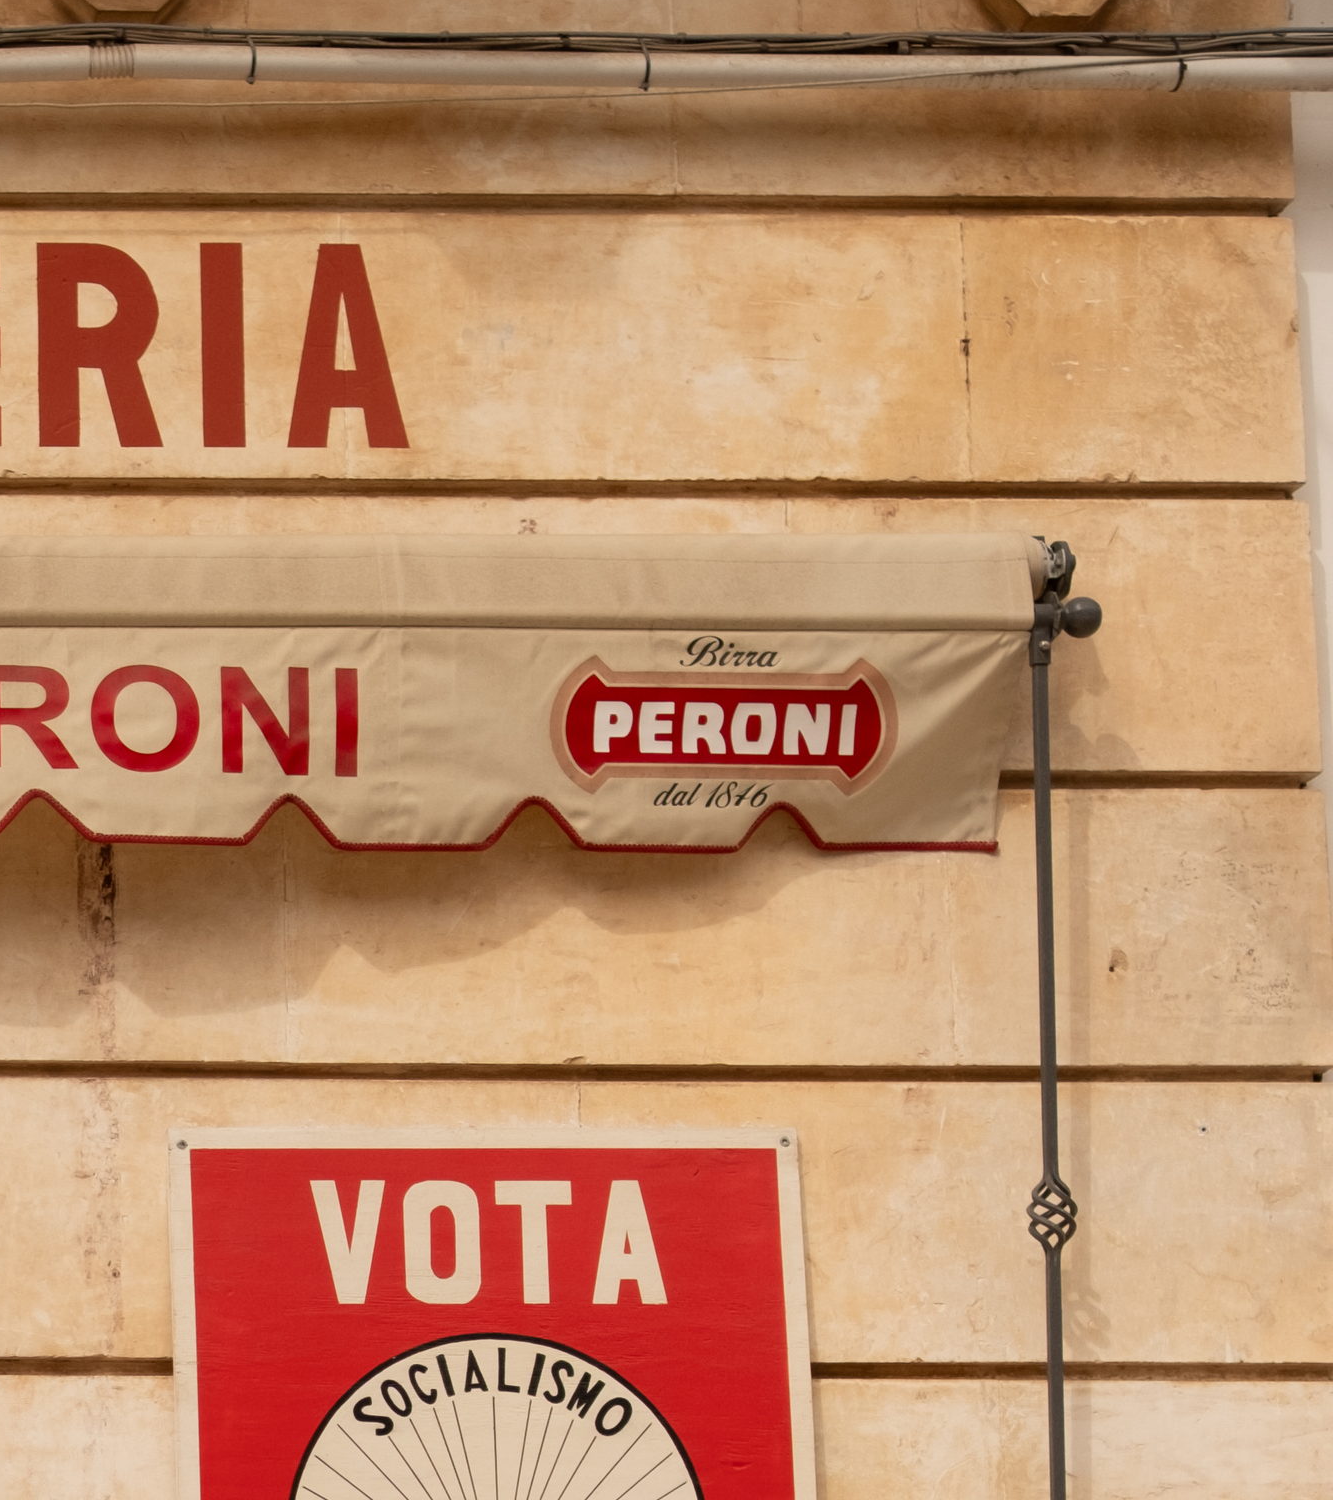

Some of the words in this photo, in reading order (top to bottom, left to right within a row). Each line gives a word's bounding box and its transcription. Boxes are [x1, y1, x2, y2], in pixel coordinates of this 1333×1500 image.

[680, 636, 782, 669] Birra
[593, 701, 858, 756] PERONI
[653, 782, 698, 808] dal
[704, 782, 769, 809] 1846
[309, 1179, 668, 1306] VOTA
[353, 1346, 634, 1438] SOCIALISMO
